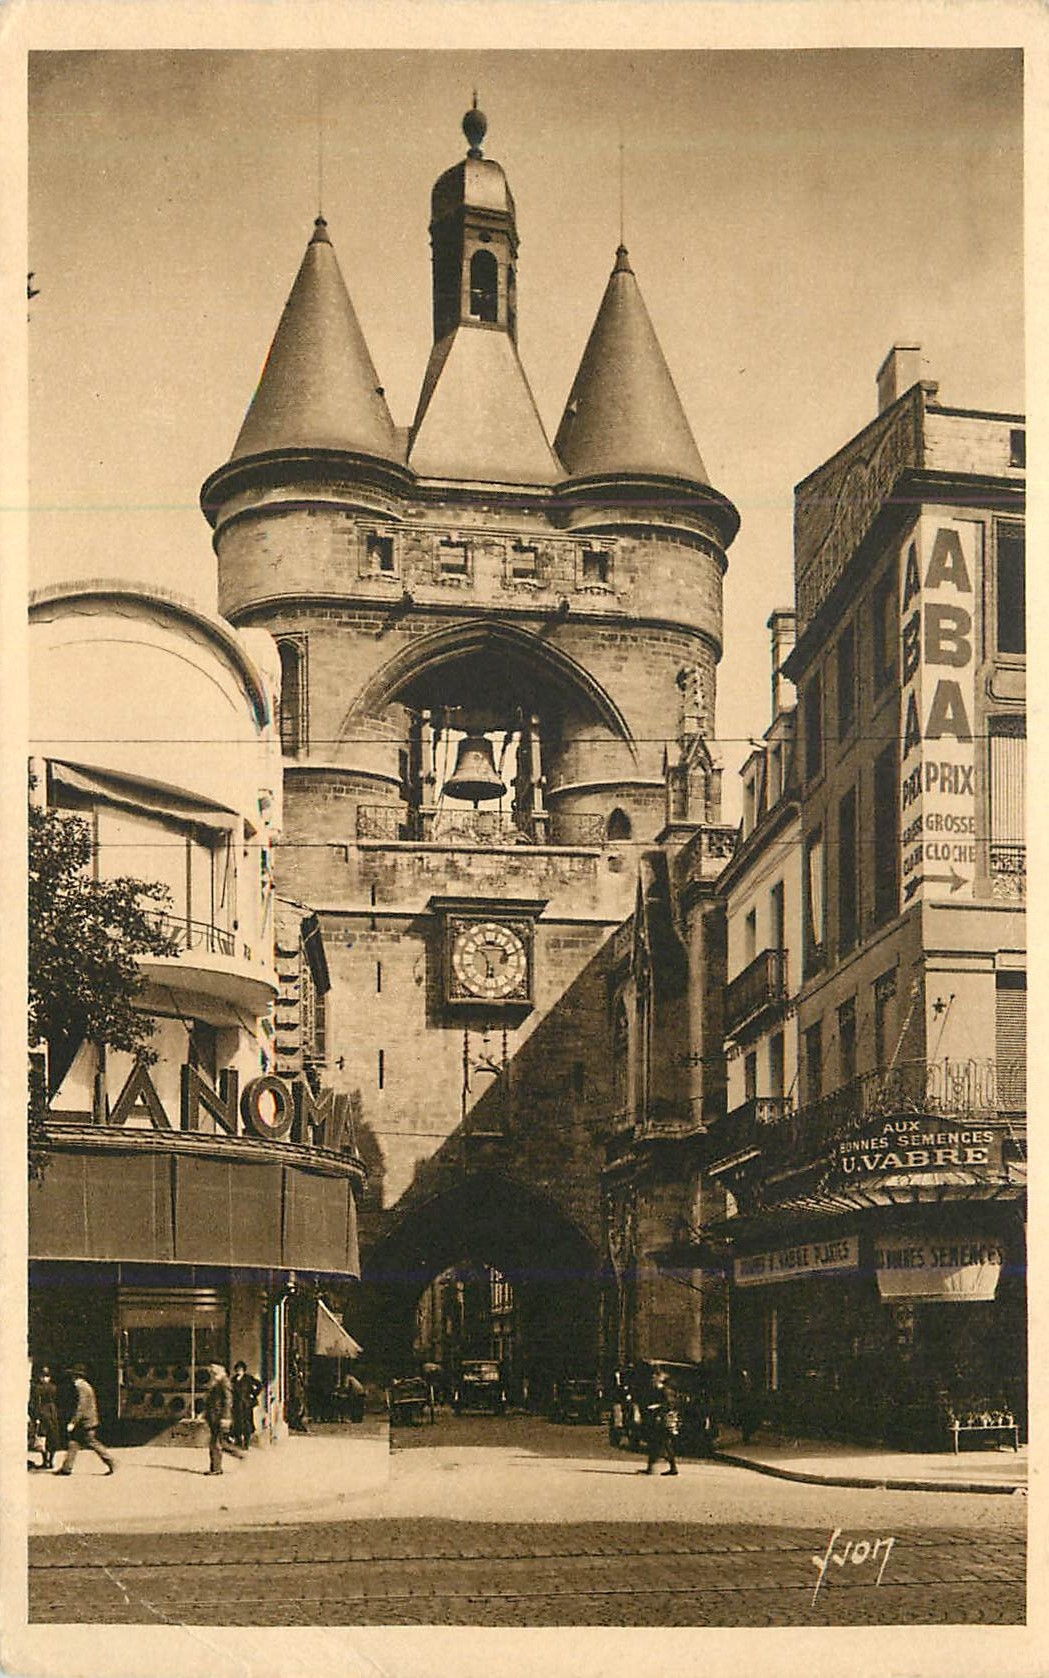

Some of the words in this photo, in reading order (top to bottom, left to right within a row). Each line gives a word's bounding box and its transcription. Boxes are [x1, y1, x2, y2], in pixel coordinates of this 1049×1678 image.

[923, 528, 972, 743] ABA
[925, 761, 974, 795] PRIX
[925, 813, 975, 833] GROSSE
[925, 844, 975, 863] CLOCHE
[883, 1121, 919, 1134] AUX
[840, 1137, 888, 1153] BONNES
[897, 1131, 993, 1147] SEMENCES
